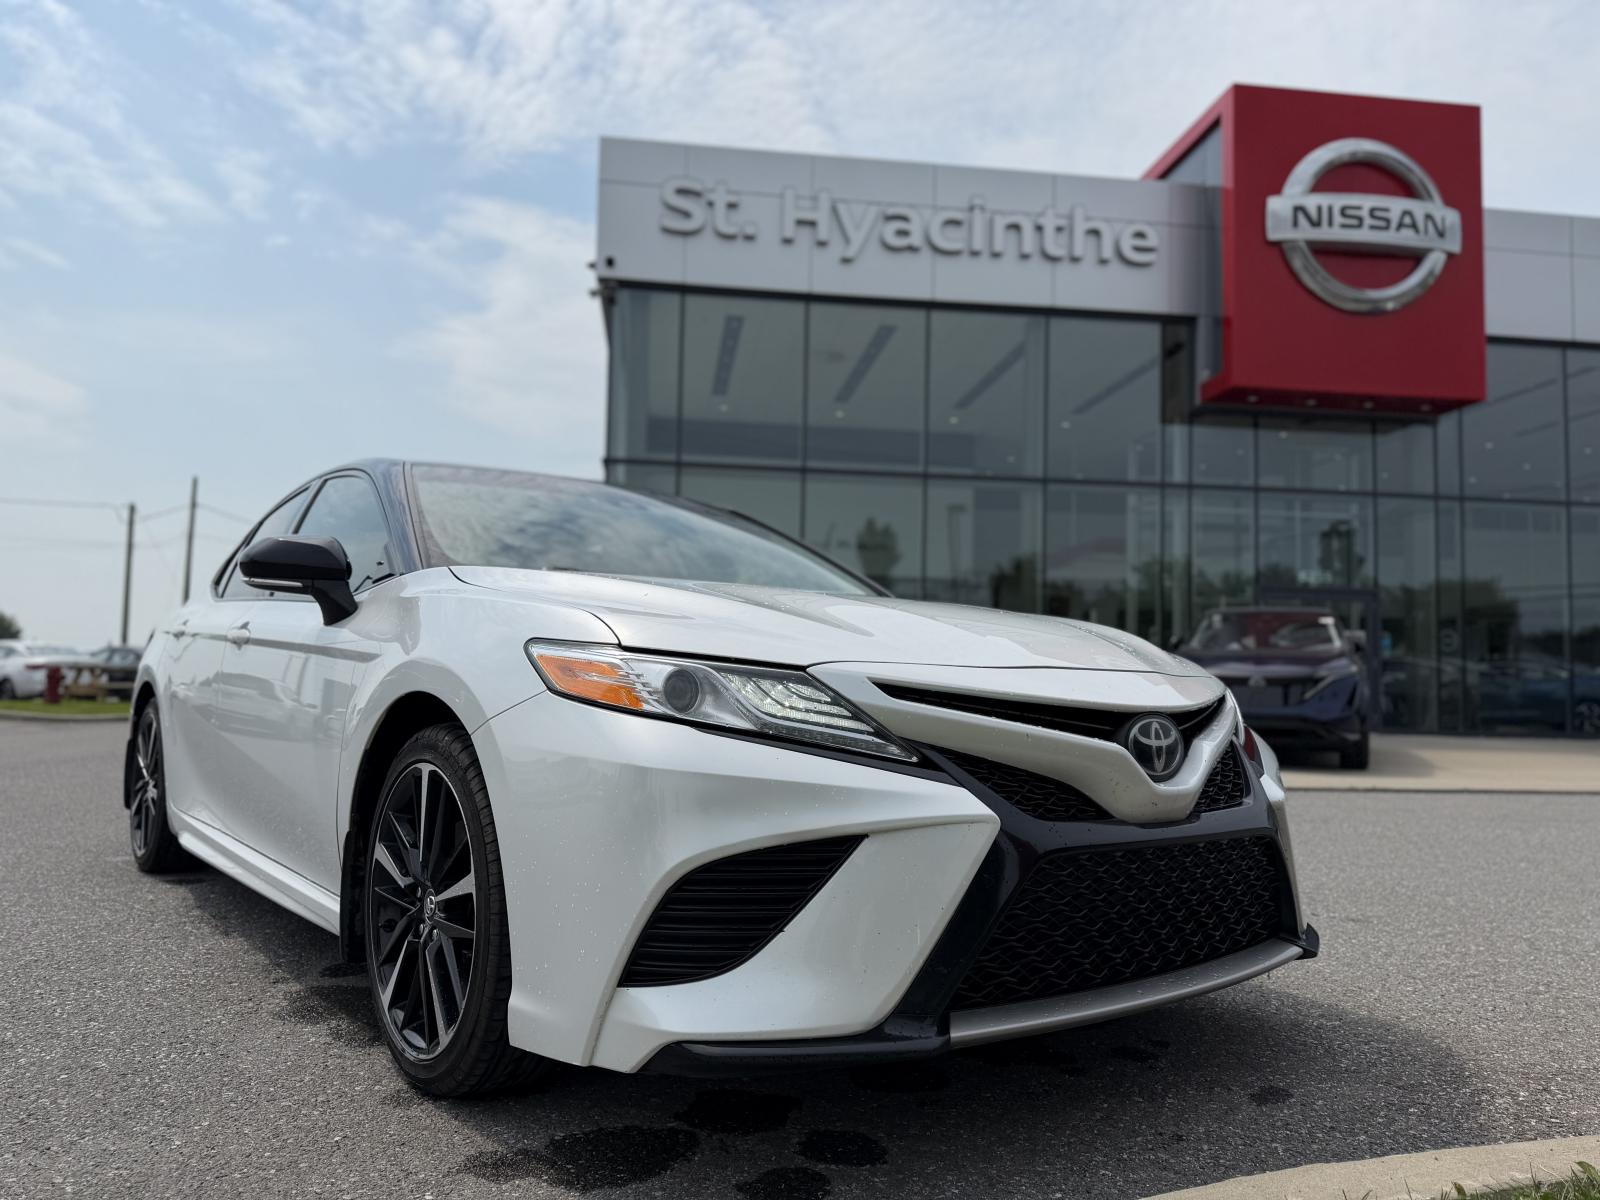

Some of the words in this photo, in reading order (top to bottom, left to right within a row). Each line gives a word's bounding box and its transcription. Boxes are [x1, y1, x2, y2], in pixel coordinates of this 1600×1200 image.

[660, 177, 757, 241] St.
[780, 187, 1160, 266] Hyacinthe
[1292, 204, 1447, 239] NISSAN
